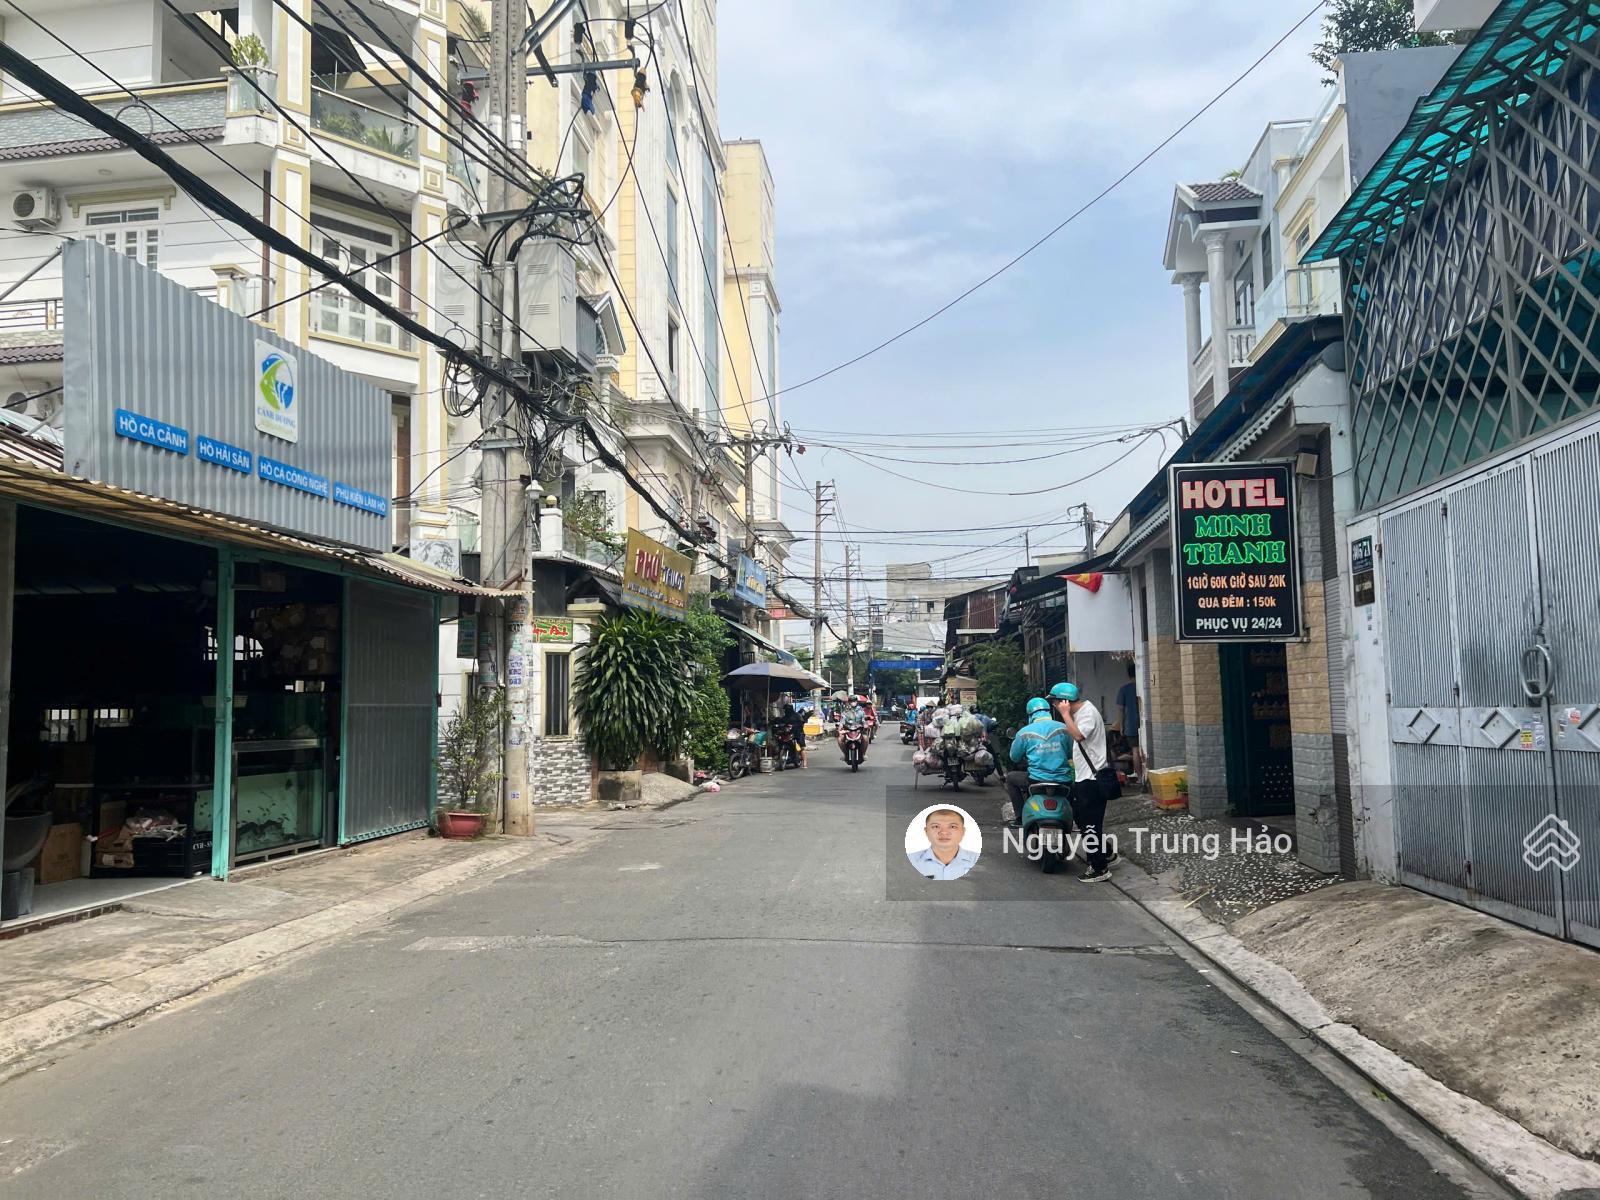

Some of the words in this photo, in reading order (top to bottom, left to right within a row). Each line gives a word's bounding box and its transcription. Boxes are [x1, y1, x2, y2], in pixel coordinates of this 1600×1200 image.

[119, 415, 138, 433] HỒ
[139, 423, 156, 439] CÁ
[156, 426, 187, 448] CẢNH
[199, 440, 215, 457] HỒ
[215, 444, 231, 462] HẢI
[231, 450, 250, 469] SẢN
[260, 460, 273, 476] HỒ
[285, 469, 308, 487] CÔNG
[1182, 478, 1286, 509] HOTEL
[1194, 513, 1272, 538] MINH
[1183, 541, 1286, 566] THANH
[1187, 573, 1209, 590] 1GIỜ
[1210, 575, 1228, 590] 60K
[1229, 572, 1248, 589] GIỜ
[1248, 574, 1267, 589] SAU
[1268, 574, 1287, 588] 20K
[1198, 596, 1220, 609] QUA
[1221, 594, 1245, 608] ĐÊM
[1252, 596, 1277, 608] 150k
[1196, 618, 1229, 633] PHỤC
[1231, 617, 1249, 633] VỤ
[1251, 616, 1283, 630] 24/24
